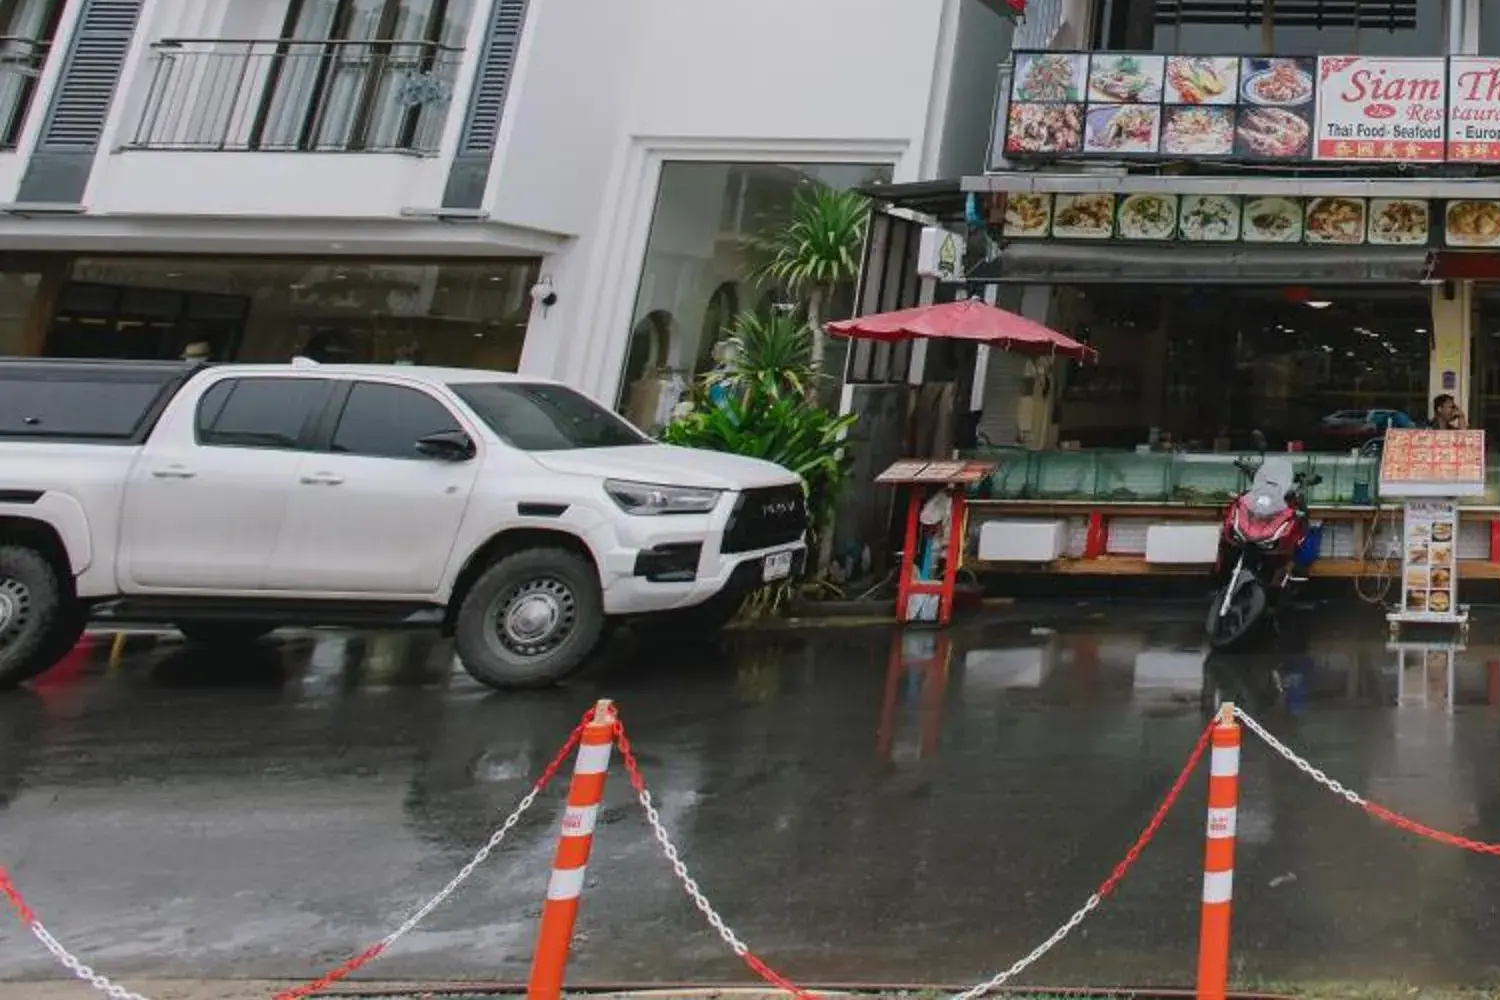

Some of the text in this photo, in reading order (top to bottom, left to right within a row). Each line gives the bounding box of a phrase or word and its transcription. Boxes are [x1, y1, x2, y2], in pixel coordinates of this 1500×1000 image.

[1341, 69, 1441, 102] Siam
[1328, 123, 1352, 137] Thai
[1357, 123, 1385, 137] Food
[1393, 125, 1441, 139] Seafood
